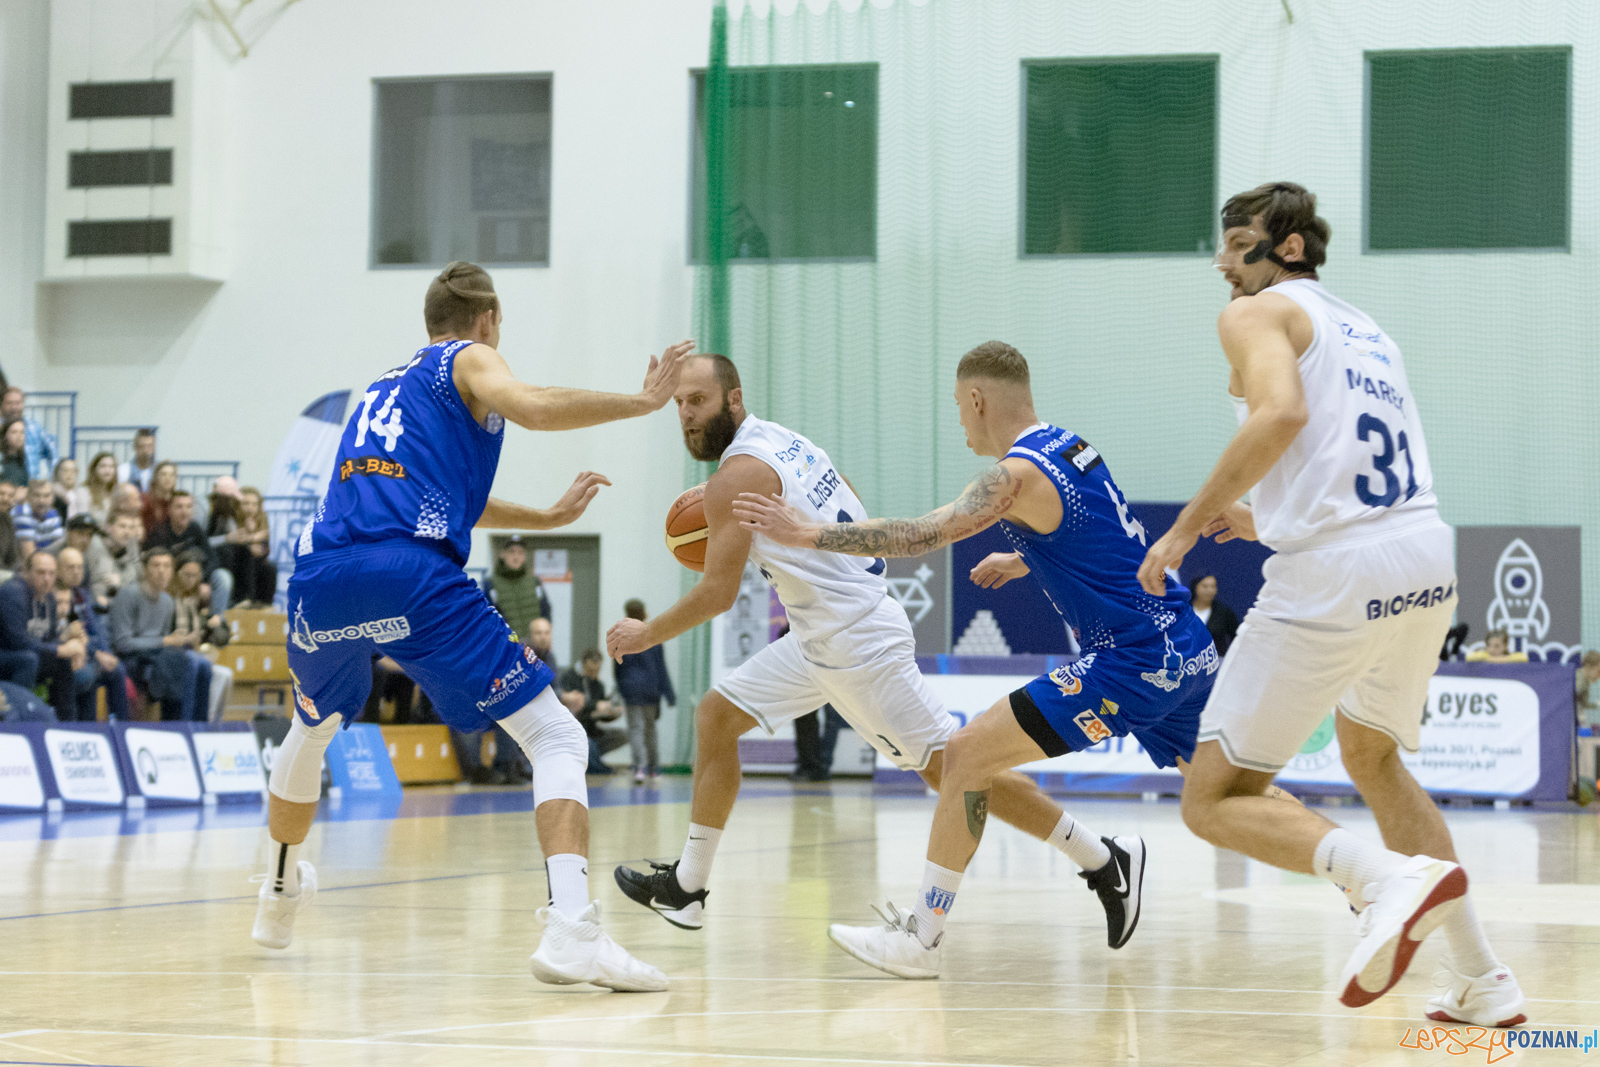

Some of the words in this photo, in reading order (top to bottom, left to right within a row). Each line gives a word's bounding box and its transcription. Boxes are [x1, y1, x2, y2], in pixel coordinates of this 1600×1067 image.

[1355, 412, 1419, 509] 31
[312, 617, 408, 642] OPOLSKIE
[1438, 692, 1498, 719] eyes
